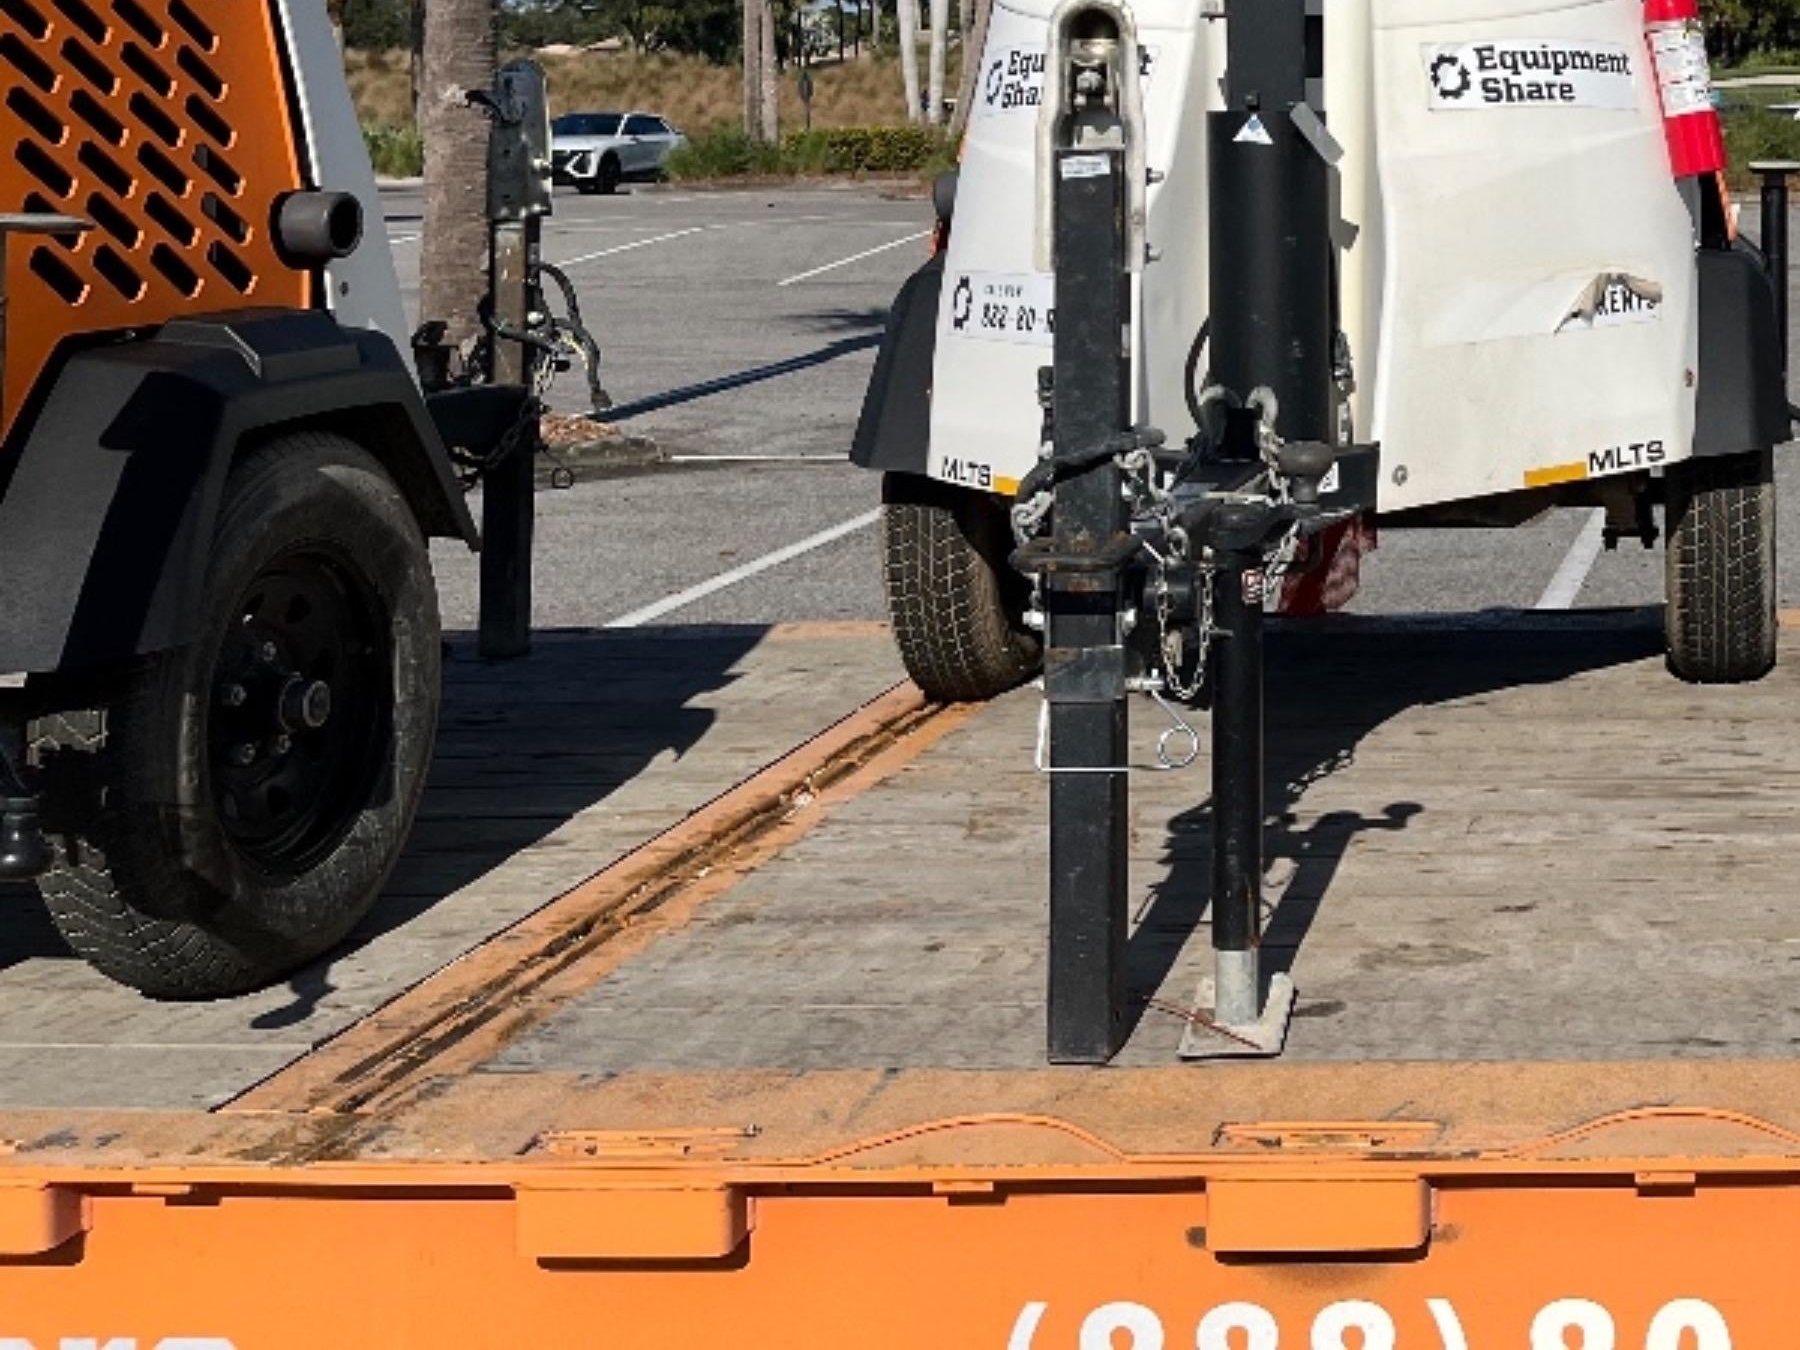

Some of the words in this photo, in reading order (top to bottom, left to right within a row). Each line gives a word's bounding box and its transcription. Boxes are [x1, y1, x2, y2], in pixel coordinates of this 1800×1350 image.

[1473, 44, 1632, 76] Equipment
[1481, 77, 1575, 103] Share
[1589, 440, 1666, 471] MLTS
[942, 456, 992, 486] MLTS
